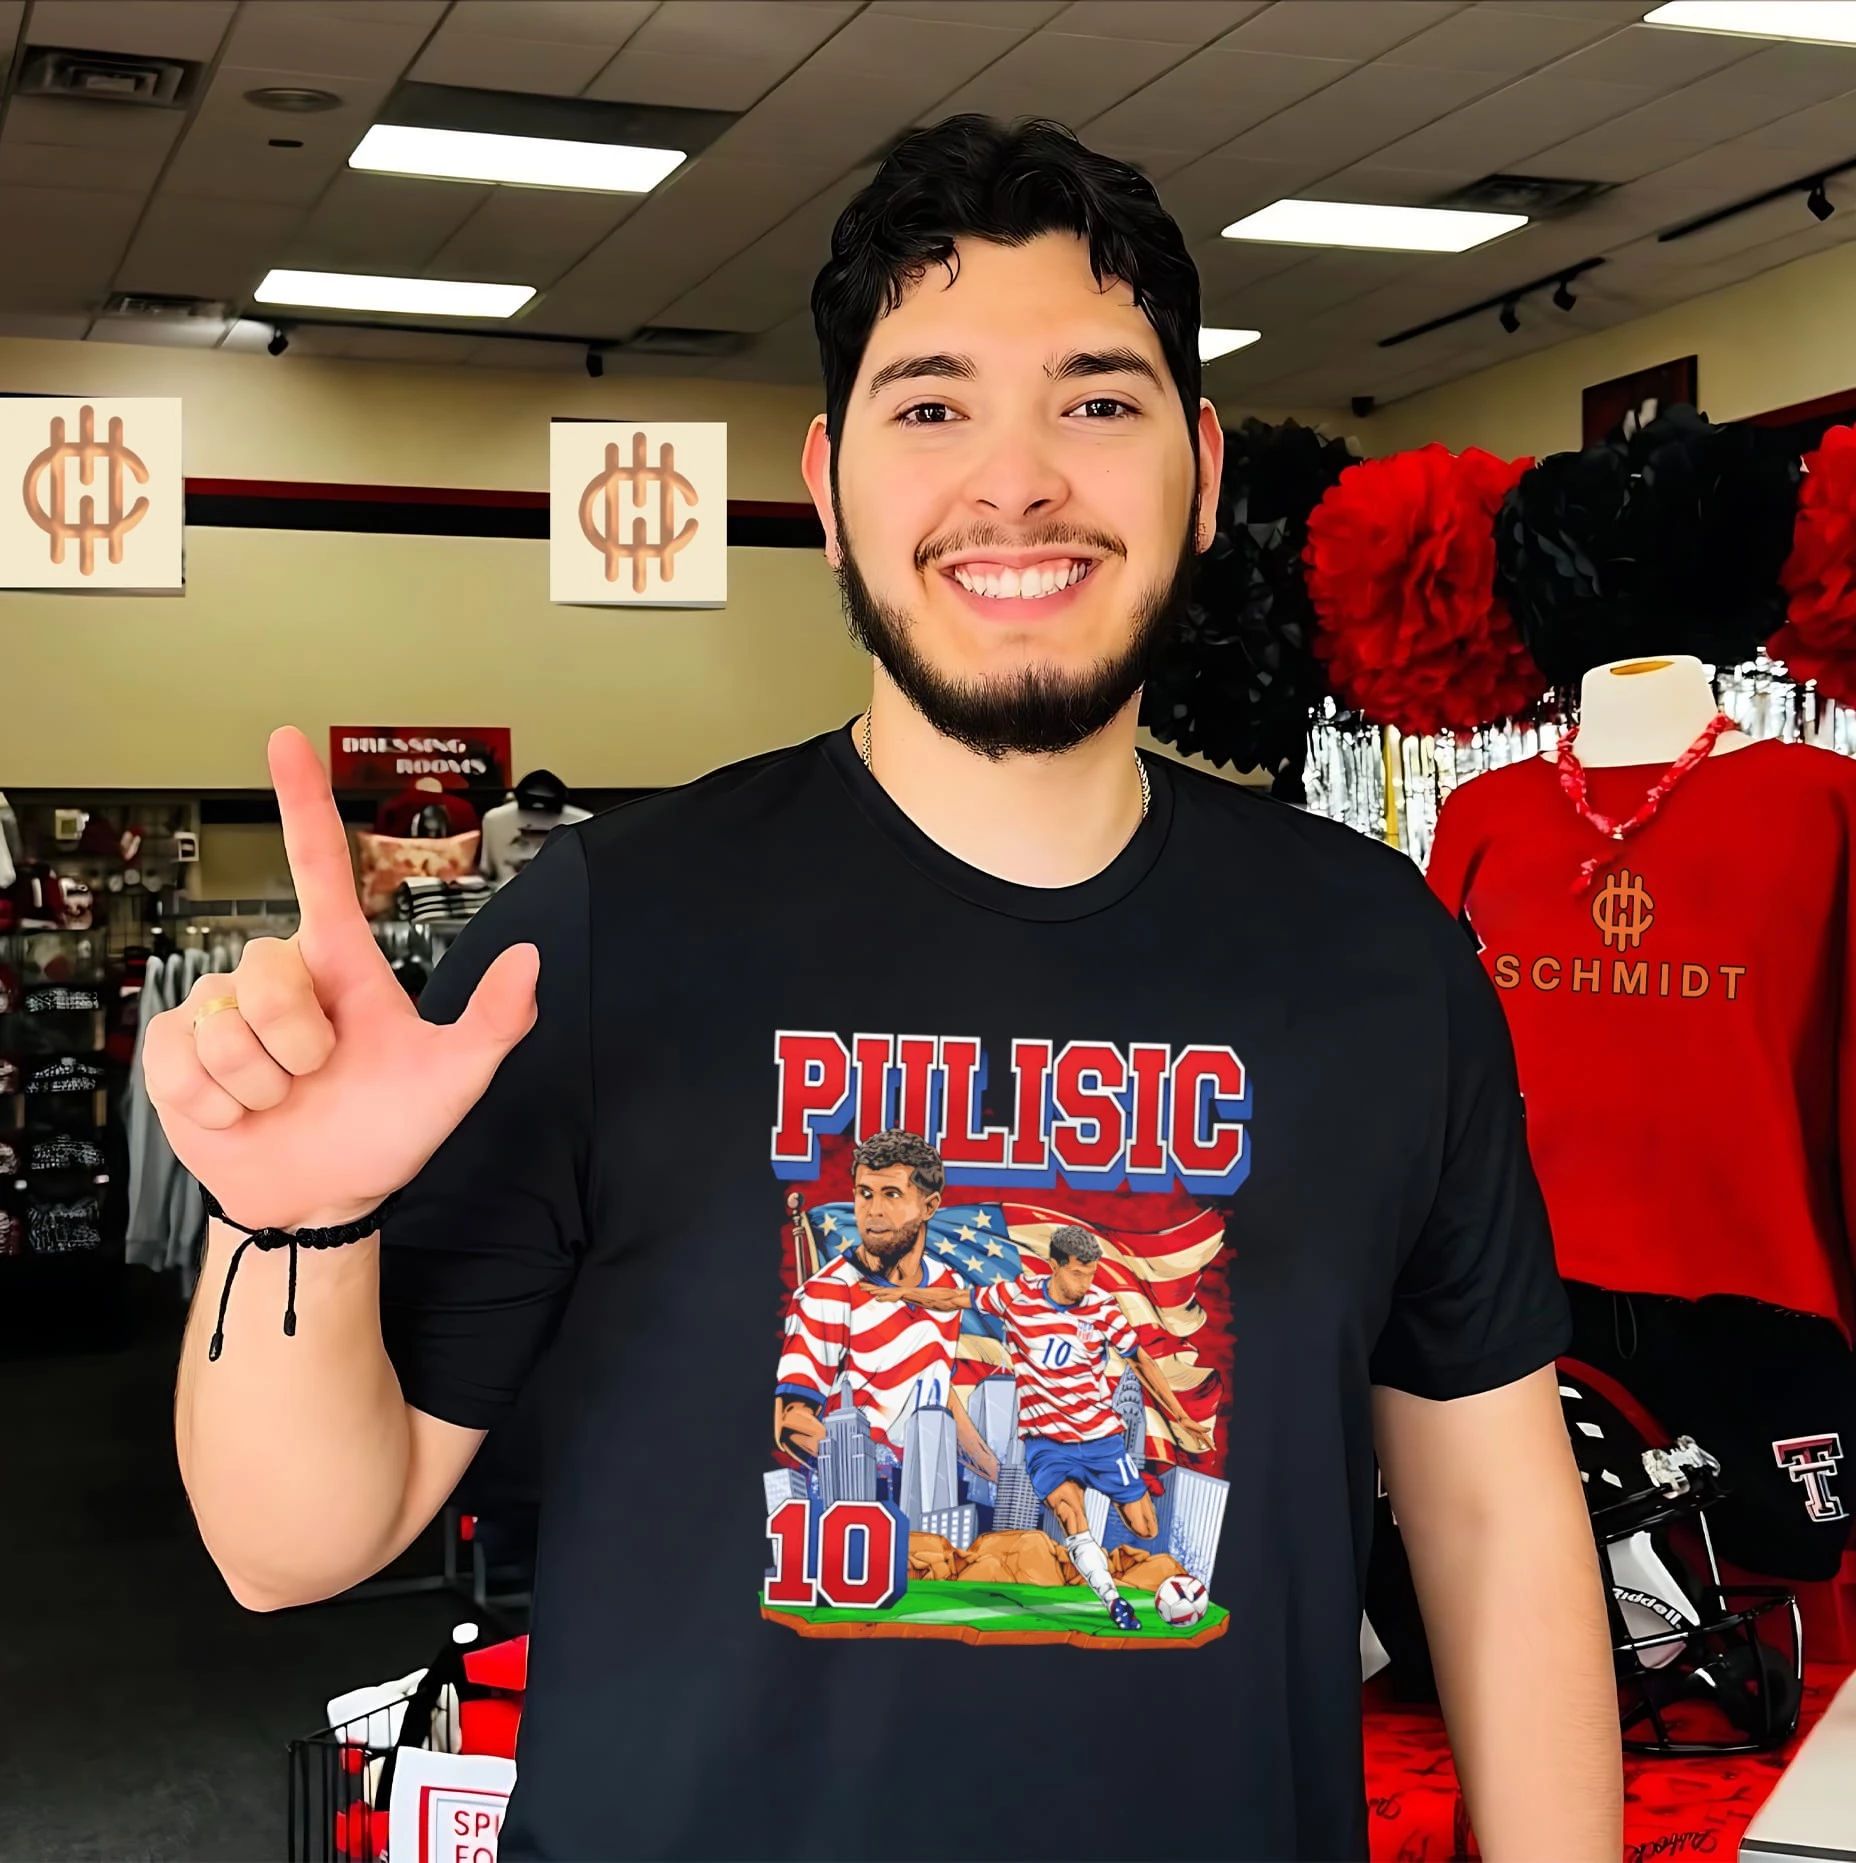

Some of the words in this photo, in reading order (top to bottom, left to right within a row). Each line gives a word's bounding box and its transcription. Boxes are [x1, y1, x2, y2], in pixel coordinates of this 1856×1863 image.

[1494, 953, 1747, 1001] SCHMIDT
[771, 1030, 1247, 1181] PULISIC
[1042, 1337, 1072, 1367] 10
[1116, 1453, 1140, 1486] 10
[764, 1498, 897, 1609] 10
